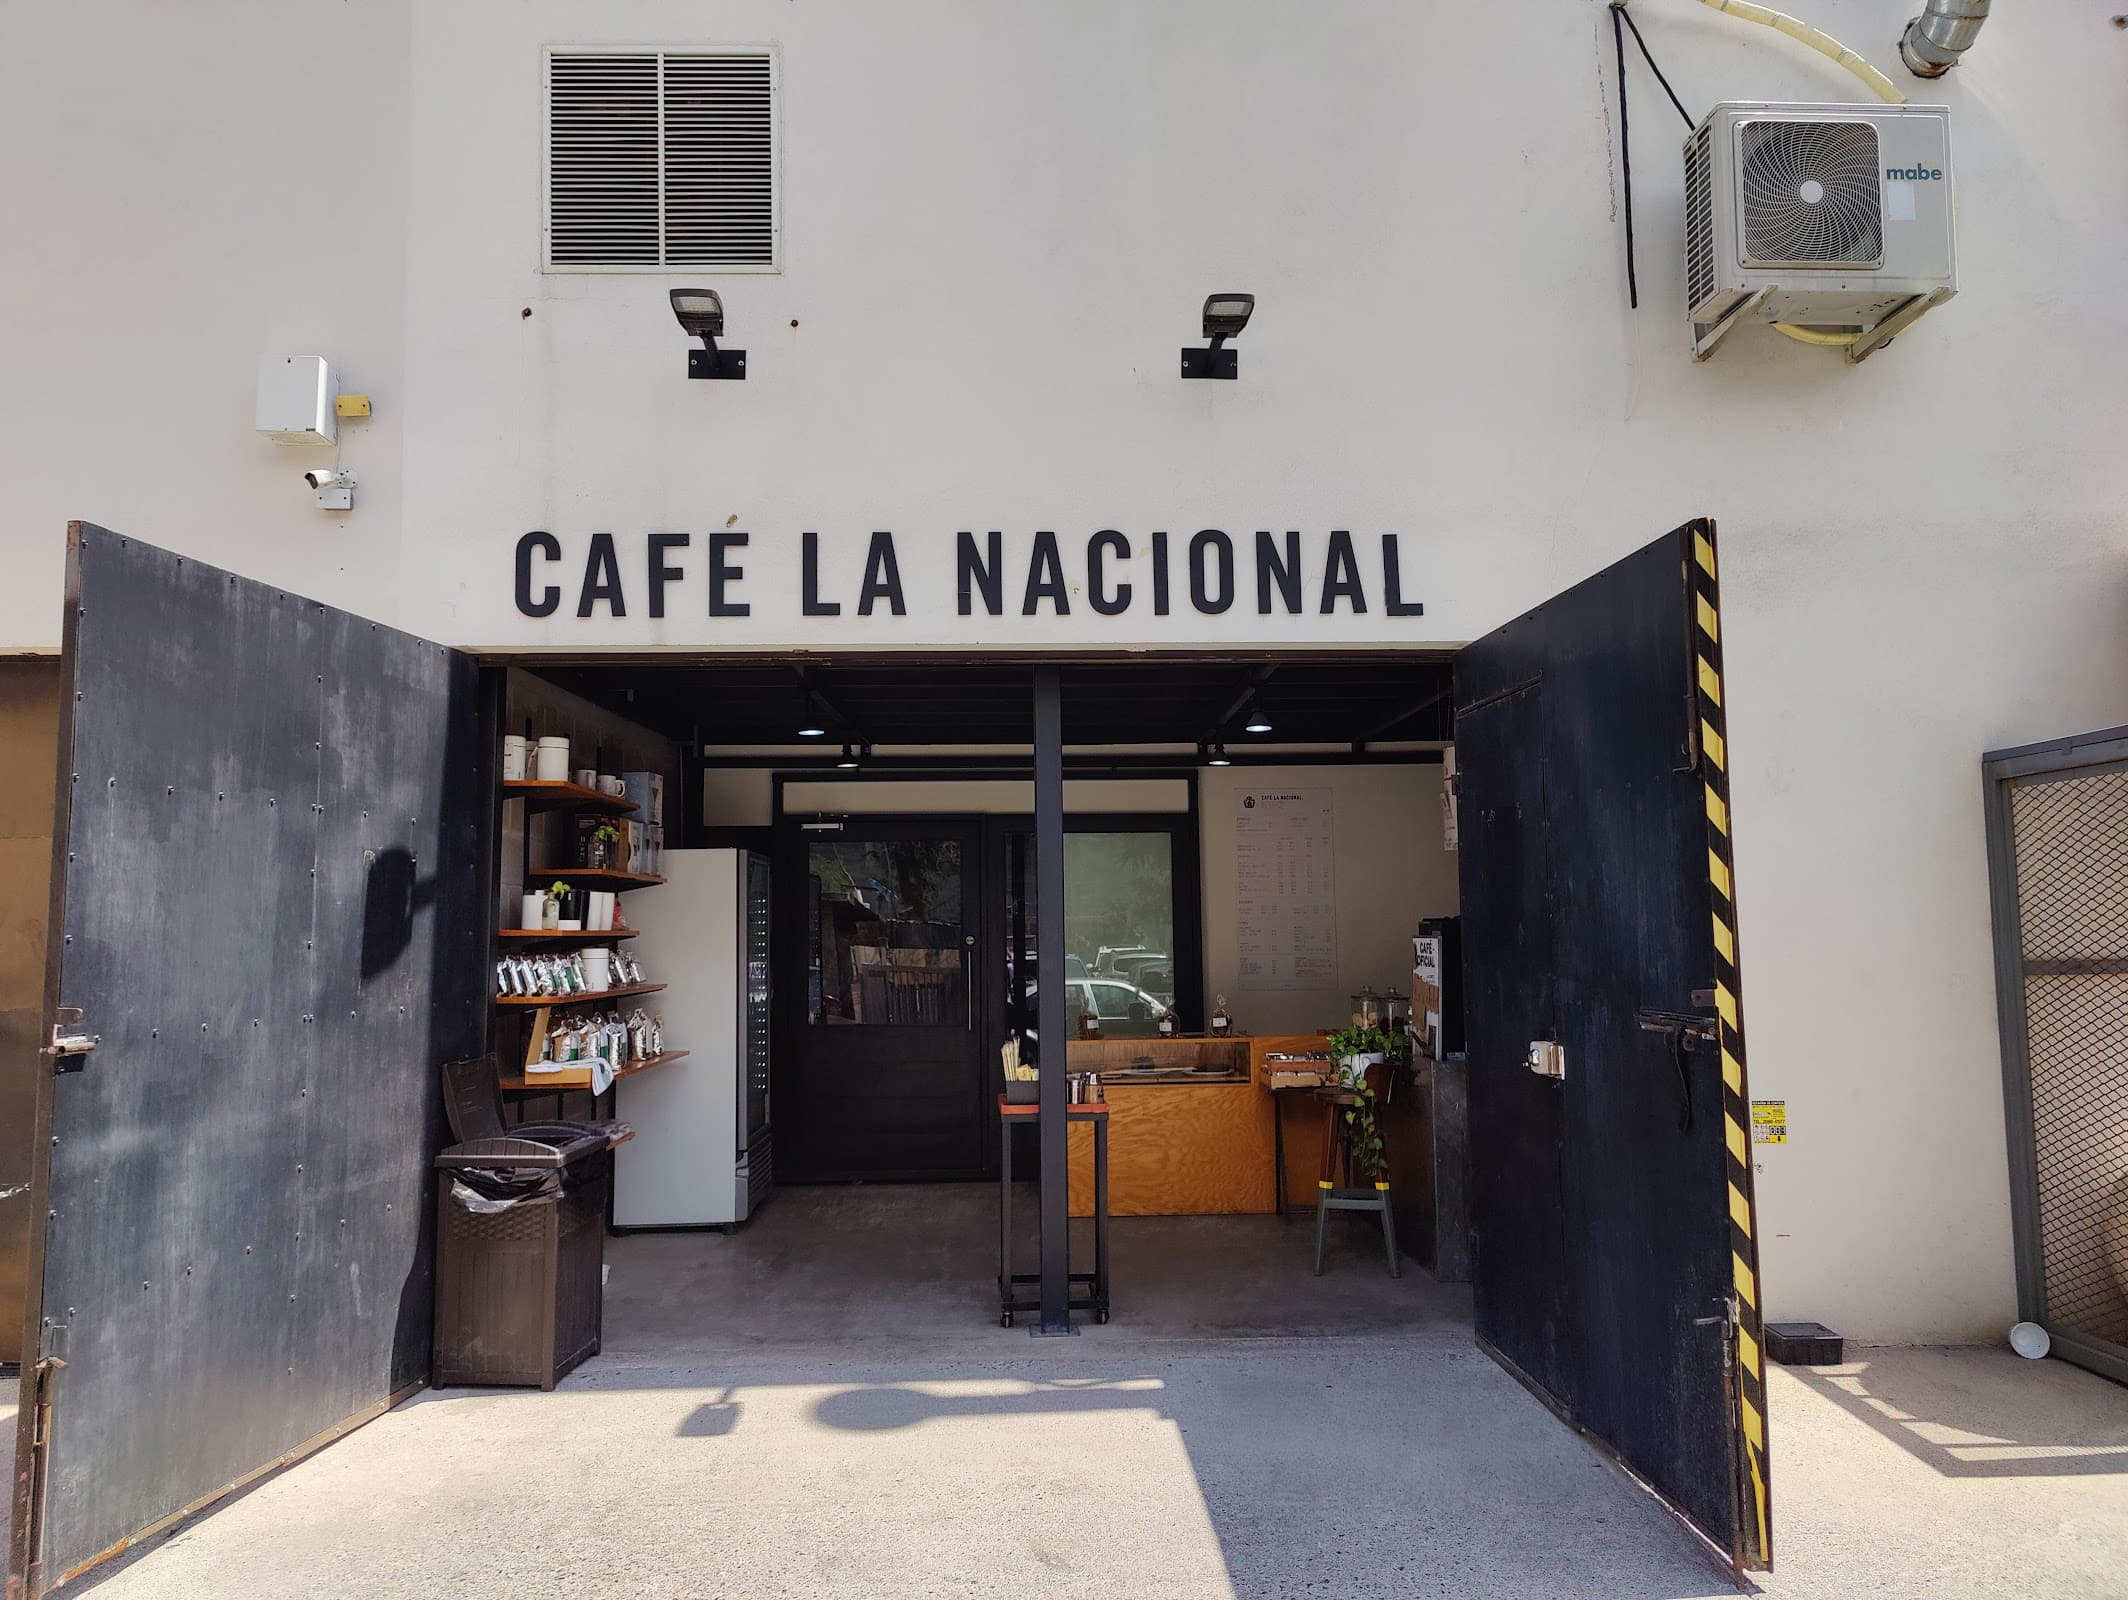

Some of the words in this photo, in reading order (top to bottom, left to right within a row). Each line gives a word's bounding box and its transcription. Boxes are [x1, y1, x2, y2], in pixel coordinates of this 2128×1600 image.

[1886, 162, 1942, 181] mabe
[803, 532, 907, 617] LA
[957, 530, 1424, 617] NACIONAL
